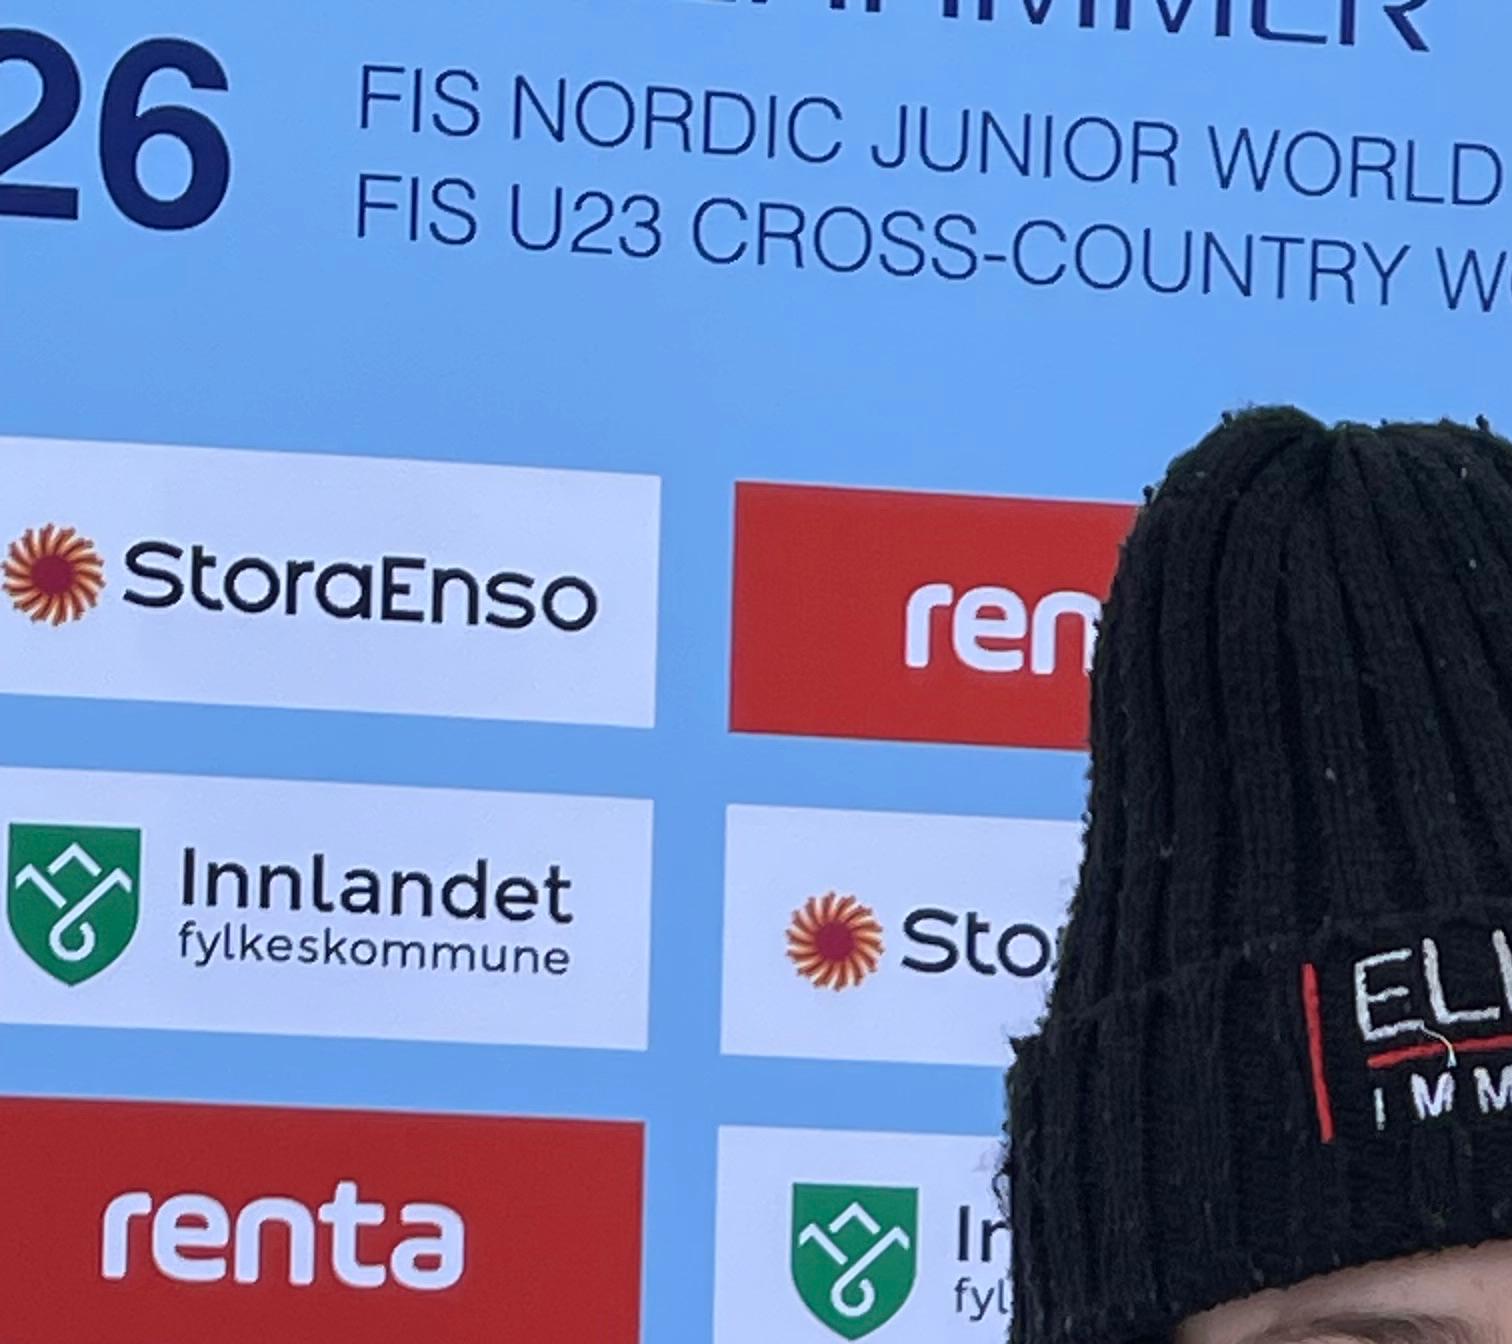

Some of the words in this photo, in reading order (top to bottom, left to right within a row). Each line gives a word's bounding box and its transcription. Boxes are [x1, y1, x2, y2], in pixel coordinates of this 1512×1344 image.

[358, 64, 481, 137] FIS
[513, 75, 843, 163] NORDIC
[871, 103, 1179, 187] JUNIOR
[1207, 124, 1502, 206] WORLD
[356, 172, 478, 246] FIS
[510, 182, 662, 258] U23
[692, 197, 1411, 306] CROSS-COUNTRY
[123, 539, 600, 633] StoraEnso
[181, 846, 574, 925] Innlandet
[179, 921, 571, 975] fylkeskommune
[102, 1179, 466, 1291] renta
